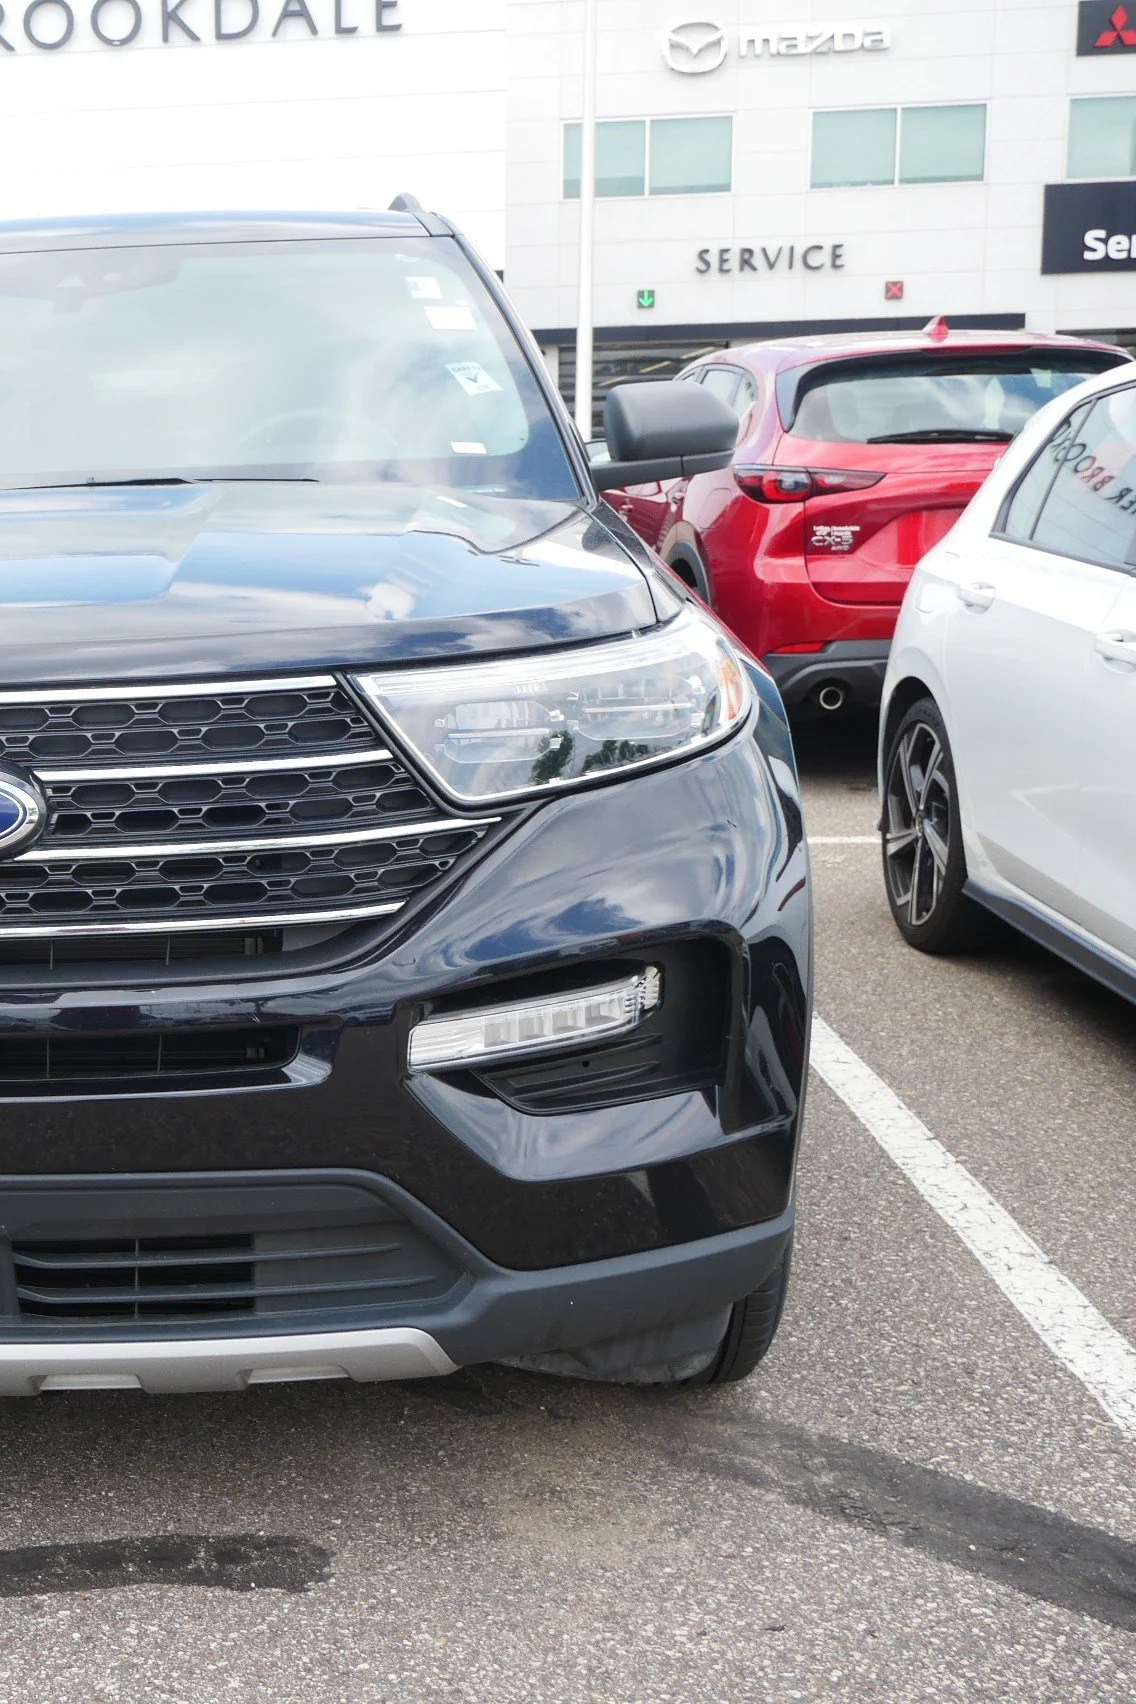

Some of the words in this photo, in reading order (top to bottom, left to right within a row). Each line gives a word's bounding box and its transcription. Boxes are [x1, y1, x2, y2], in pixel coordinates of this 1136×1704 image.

[739, 23, 891, 58] mazda
[695, 244, 845, 274] SERVICE
[811, 535, 853, 546] CX-5
